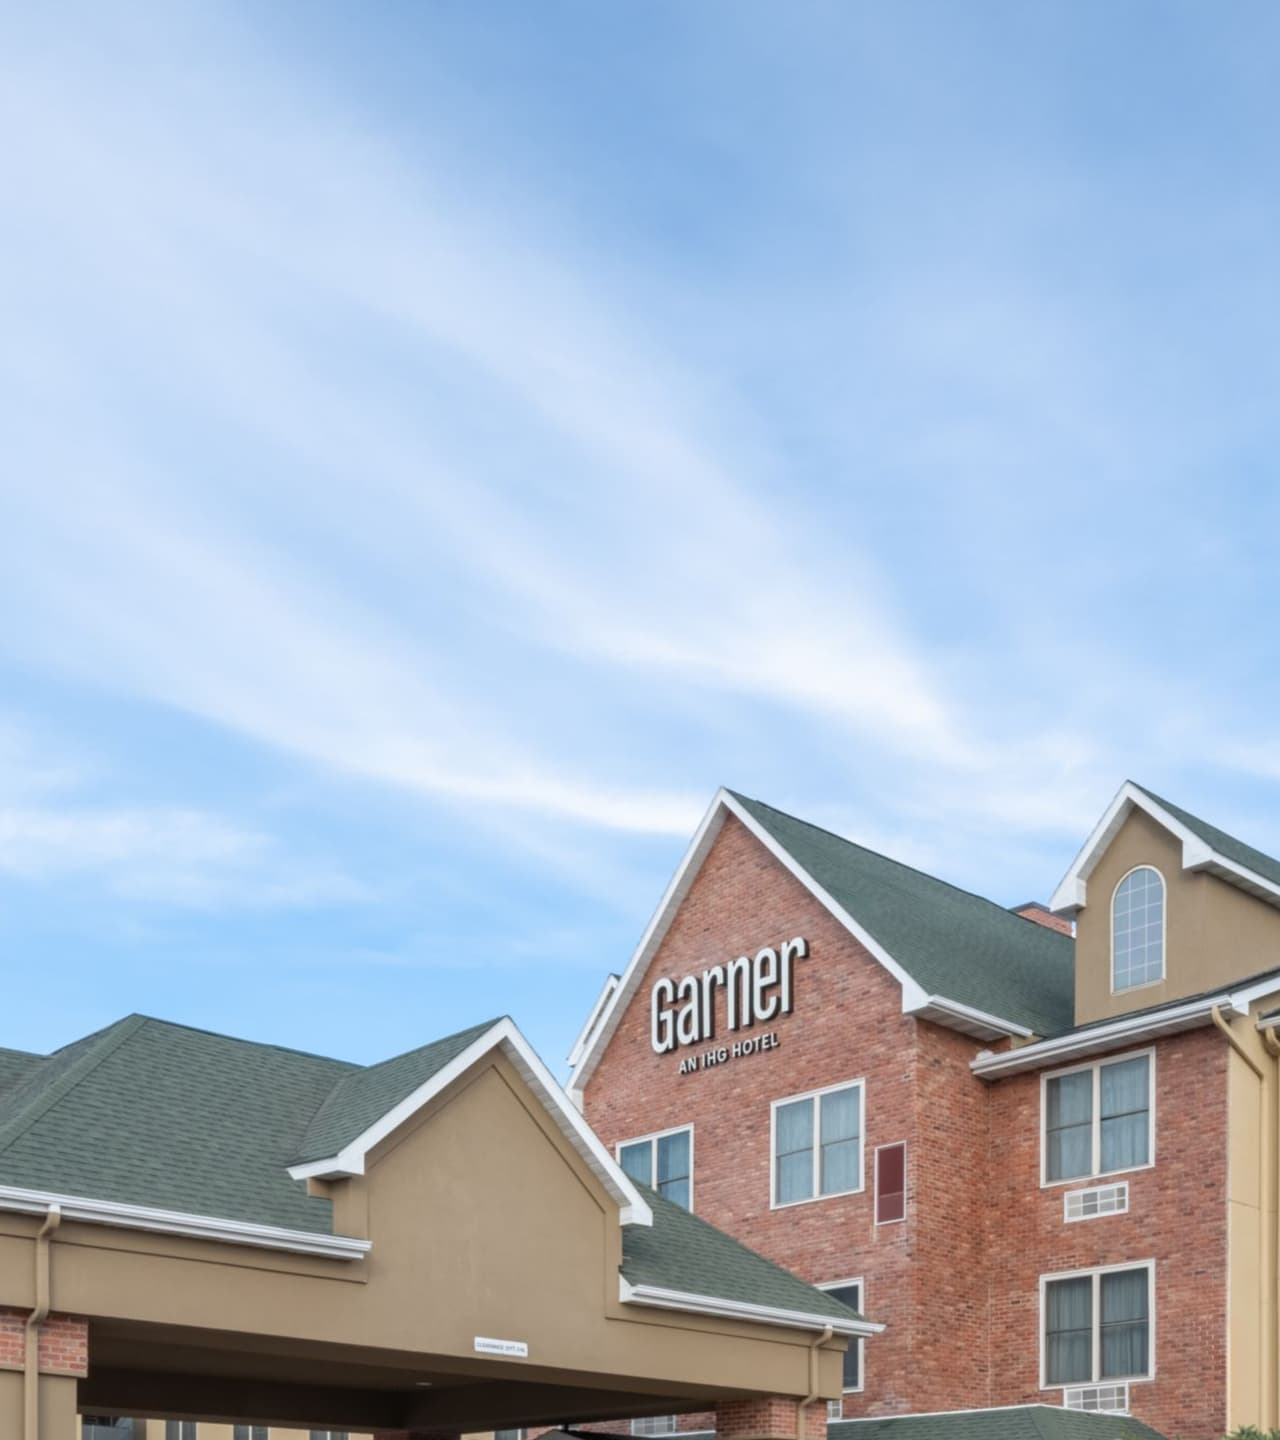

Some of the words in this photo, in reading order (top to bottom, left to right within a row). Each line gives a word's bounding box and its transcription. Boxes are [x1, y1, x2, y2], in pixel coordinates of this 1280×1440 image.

[651, 936, 807, 1054] Garner
[678, 1056, 698, 1074] AN
[701, 1047, 729, 1068] IHG
[732, 1032, 780, 1058] HOTEL
